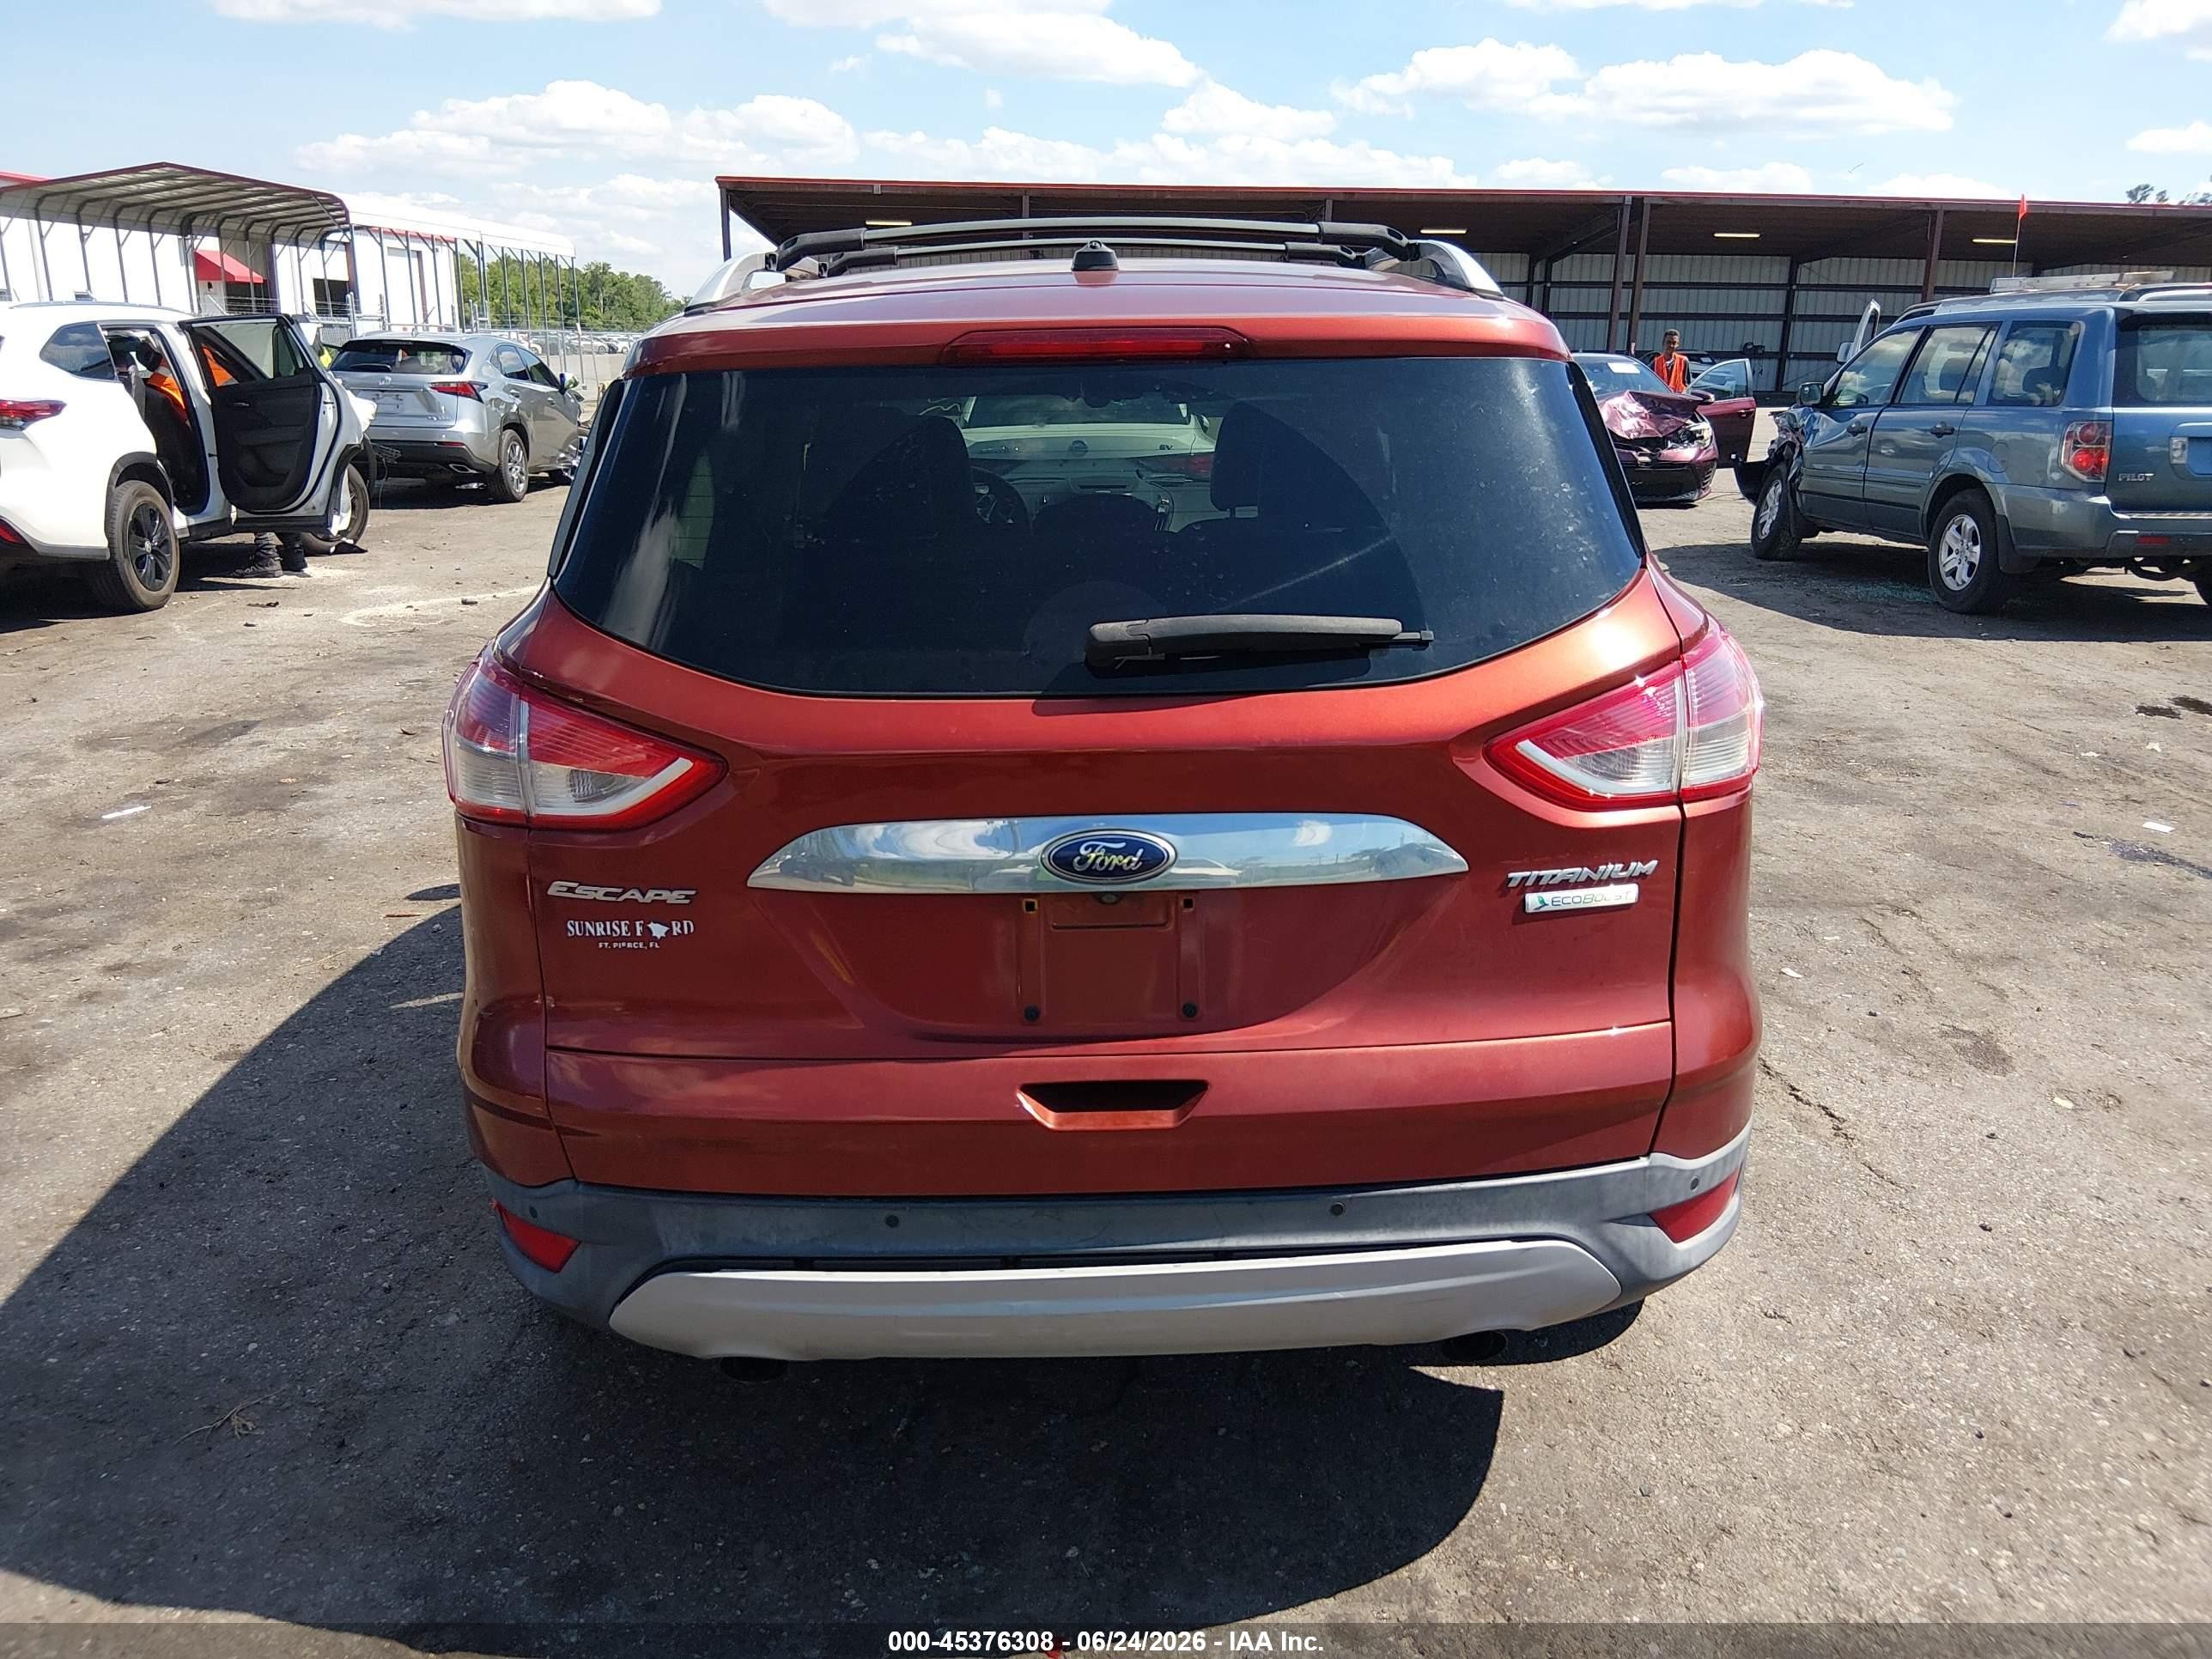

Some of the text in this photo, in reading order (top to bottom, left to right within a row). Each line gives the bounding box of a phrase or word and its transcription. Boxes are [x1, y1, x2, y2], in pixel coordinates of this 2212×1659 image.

[2118, 473, 2155, 482] PILOT
[1072, 840, 1145, 872] Ford
[1507, 860, 1659, 888] TITANIUM
[547, 880, 697, 904] ESCAPE
[567, 920, 695, 939] SUNRISE FRD
